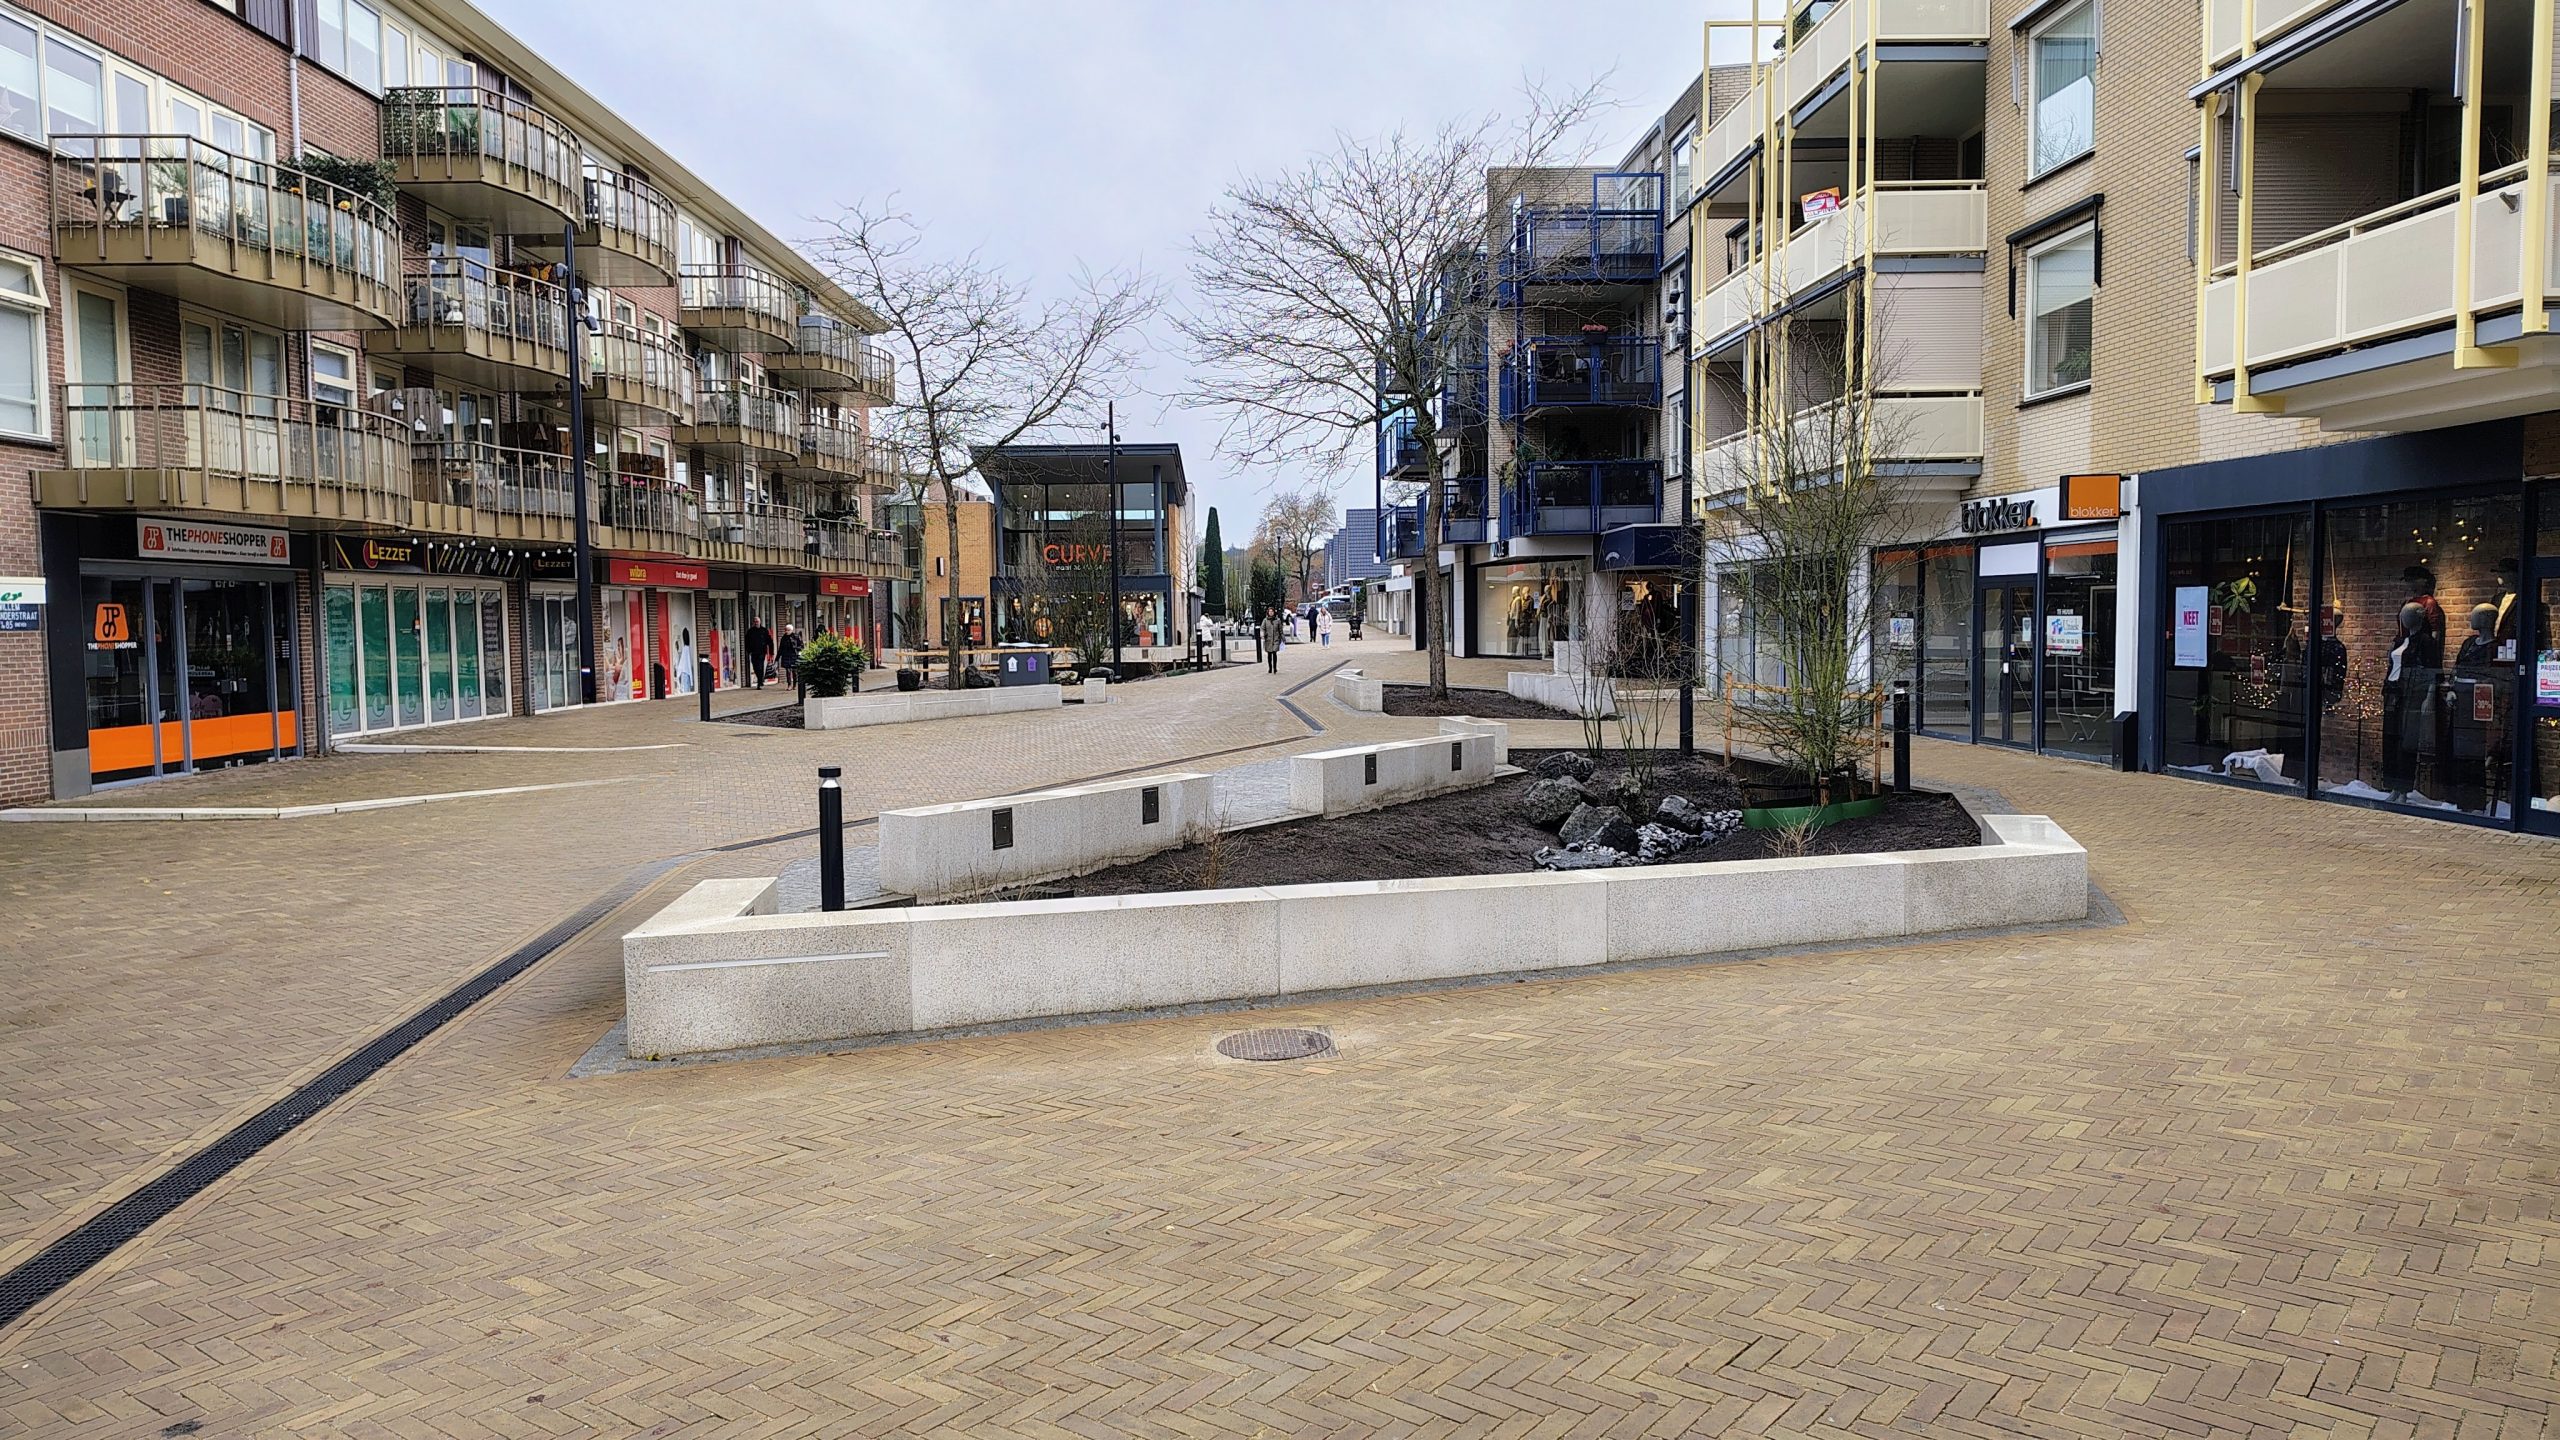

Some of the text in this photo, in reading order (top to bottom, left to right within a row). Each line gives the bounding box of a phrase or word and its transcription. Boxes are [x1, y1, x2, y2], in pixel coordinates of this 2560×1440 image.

[166, 527, 267, 548] THEPHONESHOPPER
[369, 540, 412, 562] LEZZET
[538, 559, 571, 568] LEZZET
[629, 565, 647, 578] wibra
